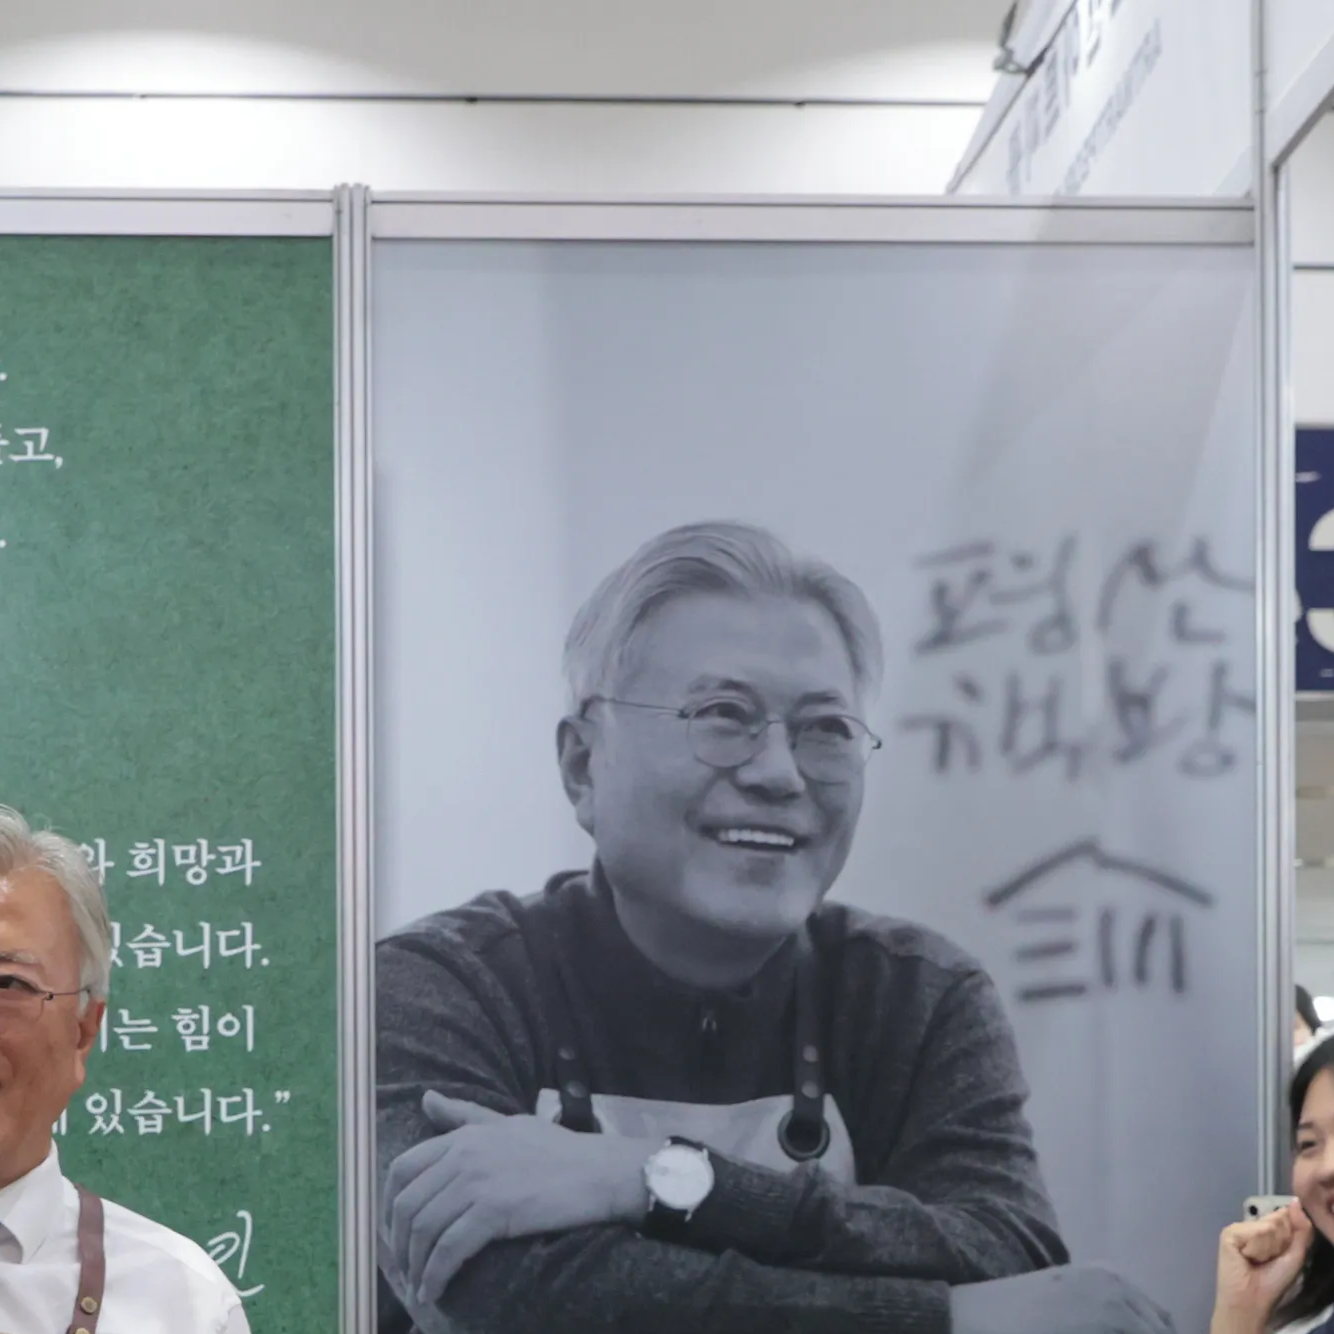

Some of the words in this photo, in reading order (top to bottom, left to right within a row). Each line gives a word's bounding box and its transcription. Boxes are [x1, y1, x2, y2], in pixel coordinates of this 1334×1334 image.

[126, 837, 263, 887] 희망과
[171, 1004, 255, 1052] 힘이
[85, 1086, 292, 1137] 있습니다.”
